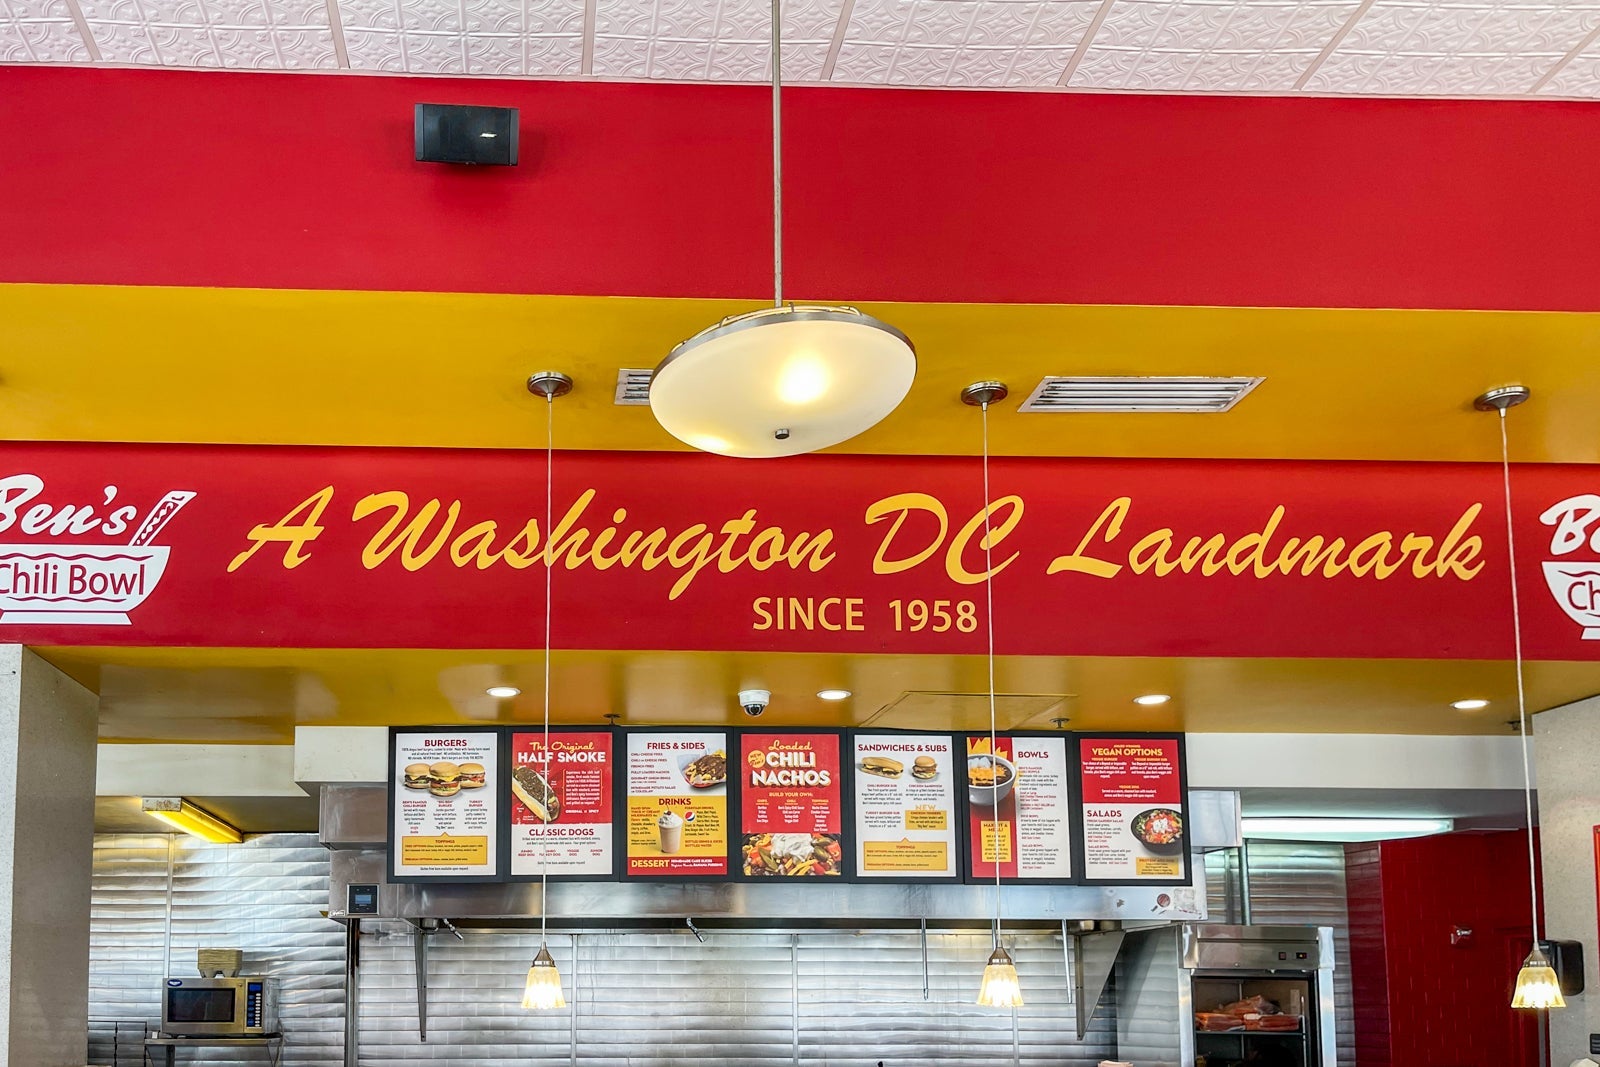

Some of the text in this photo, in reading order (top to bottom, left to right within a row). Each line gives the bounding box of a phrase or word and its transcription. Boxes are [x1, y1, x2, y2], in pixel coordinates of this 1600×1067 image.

[227, 485, 1486, 600] A Washington DC Landmark
[69, 564, 145, 595] Bowl
[753, 597, 977, 632] SINCE 1958
[424, 739, 468, 747] BURGERS
[647, 742, 705, 750] FRIES & SIDES
[768, 739, 813, 751] Loaded
[529, 741, 594, 754] The Original
[858, 744, 947, 752] SANDWICHES & SUBS
[1018, 751, 1049, 759] BOWLS
[1092, 748, 1163, 756] VEGAN OPTIONS
[518, 751, 606, 763] HALF SMOKE
[766, 751, 816, 768] CHILI
[751, 769, 832, 787] NACHOS
[658, 798, 691, 806] DRINKS
[1087, 810, 1122, 818] SALADS
[529, 828, 594, 836] CLASSIC DOGS
[631, 860, 670, 868] DESSERT
